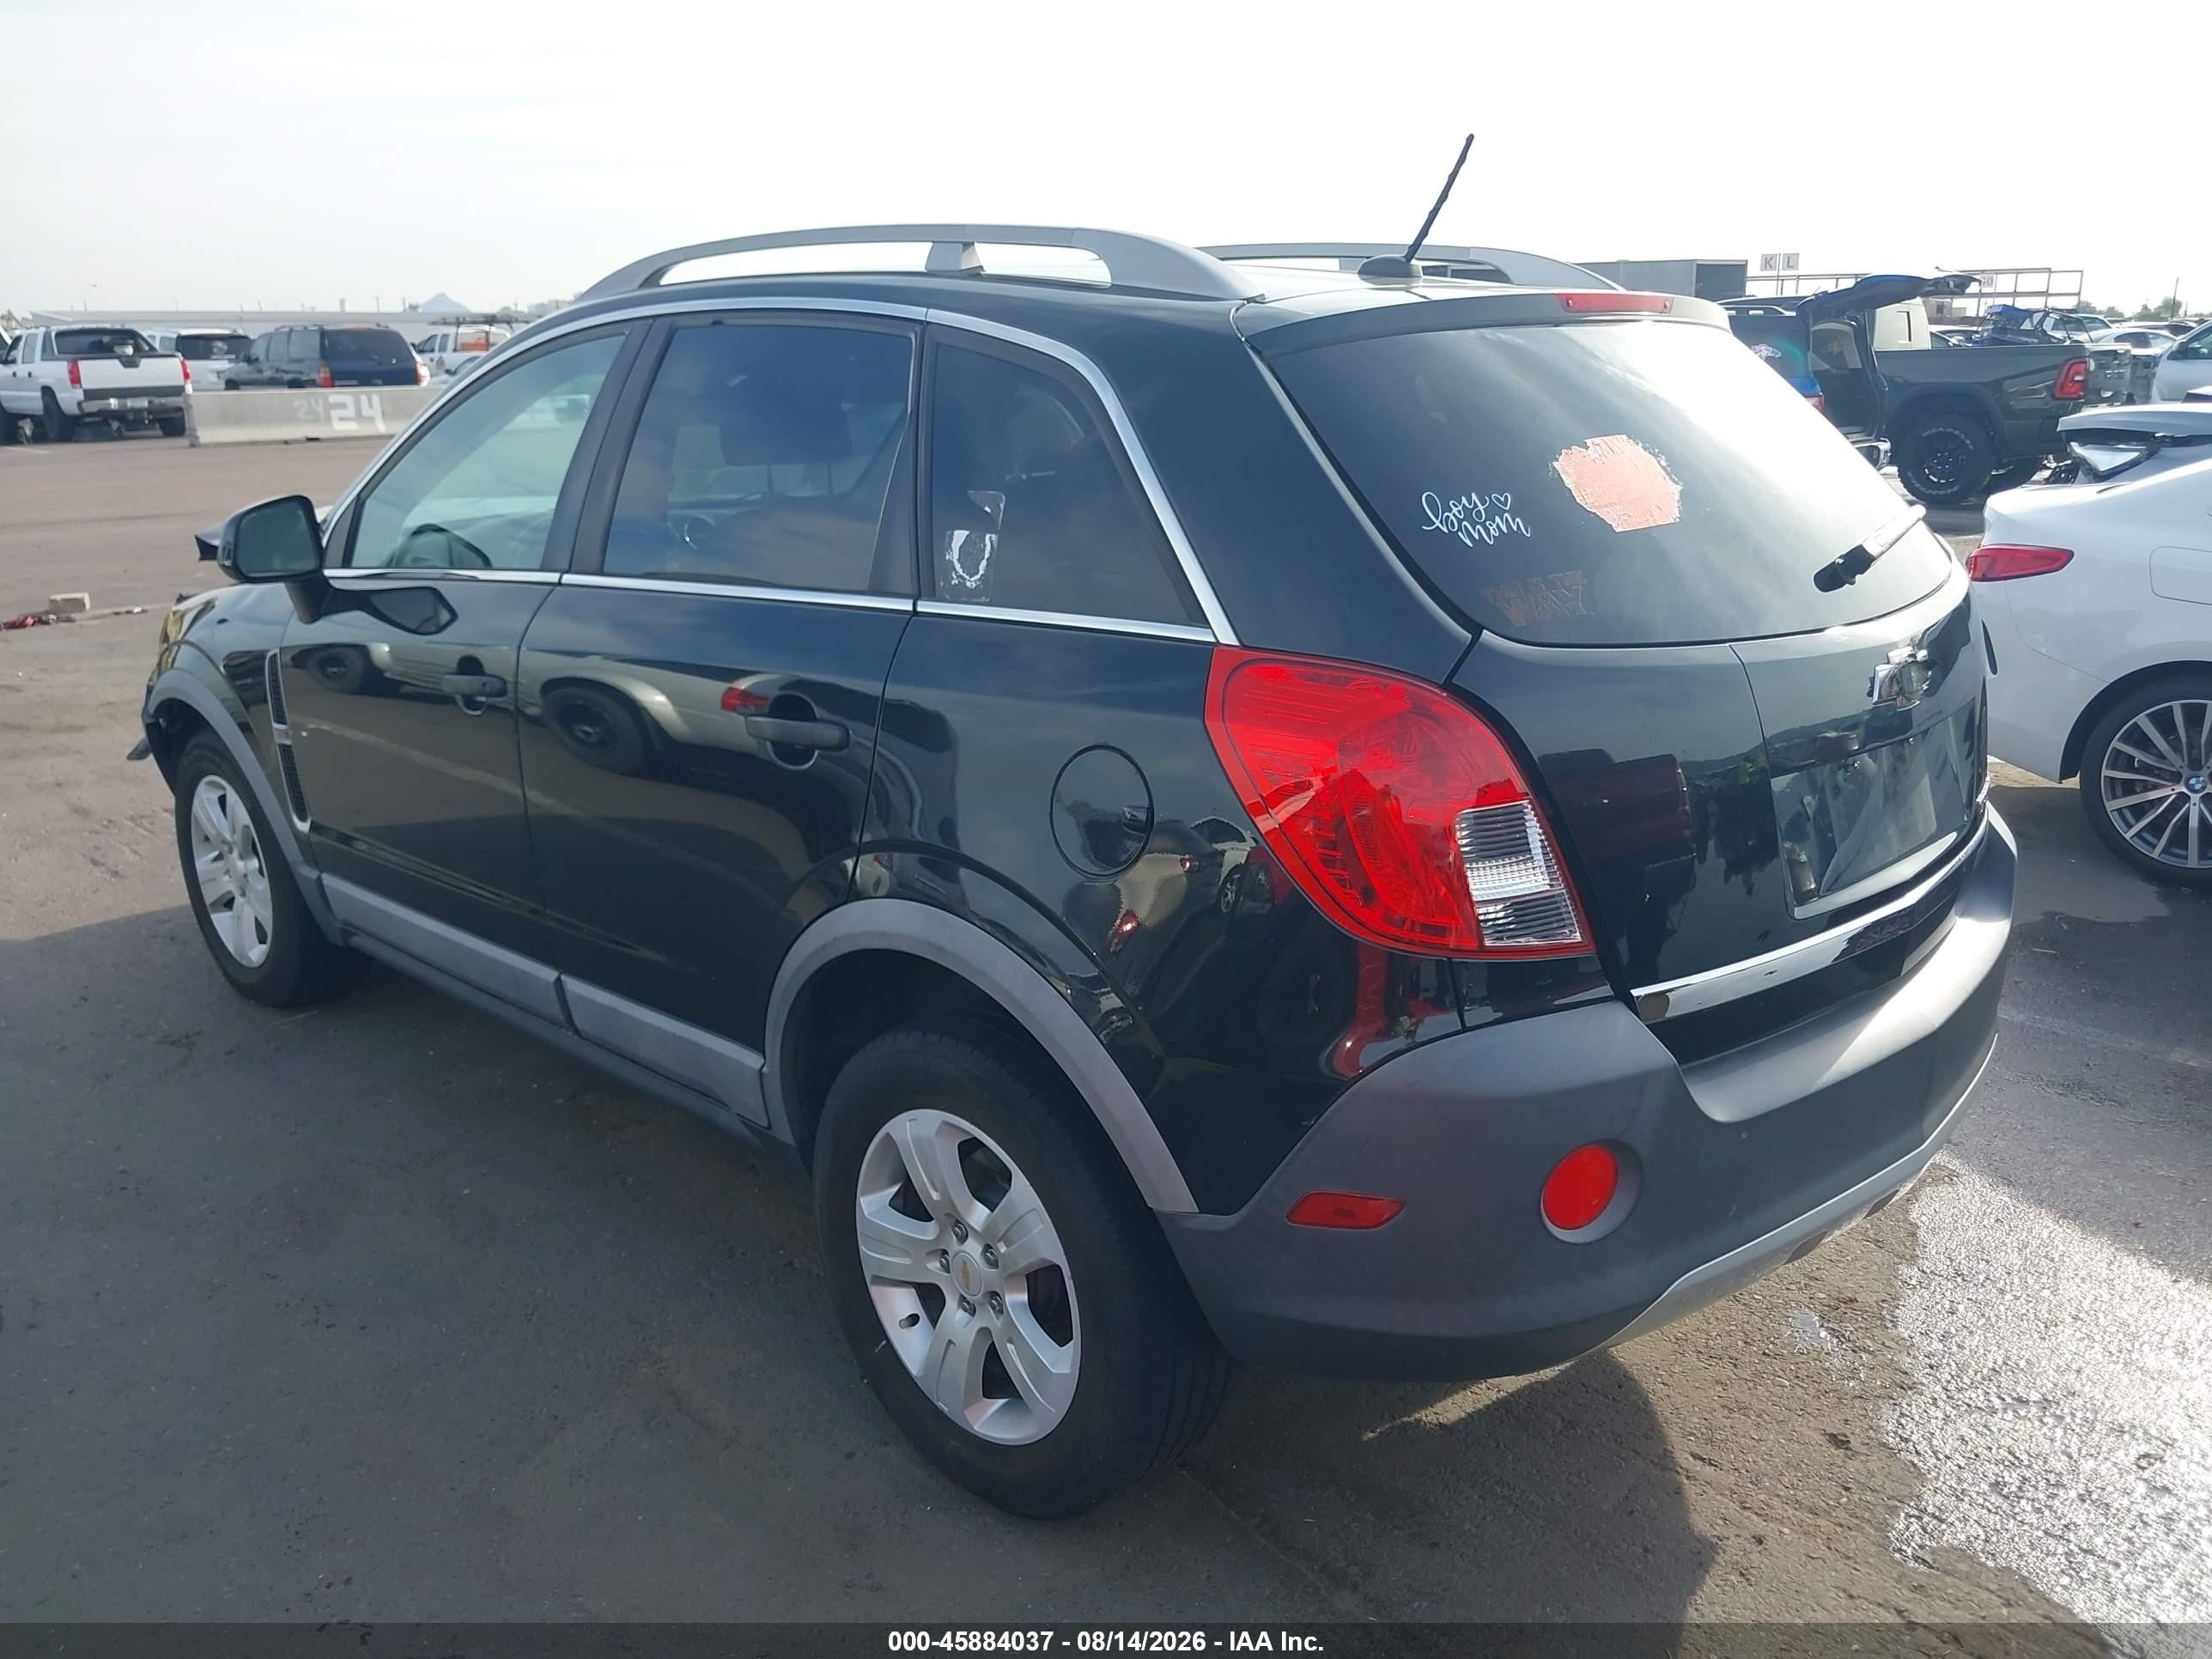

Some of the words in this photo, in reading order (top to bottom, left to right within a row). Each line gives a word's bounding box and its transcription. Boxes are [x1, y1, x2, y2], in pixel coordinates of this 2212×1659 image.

[1764, 256, 1774, 269] K
[1786, 256, 1795, 268] L
[293, 398, 325, 422] 24
[328, 394, 386, 432] 24
[1421, 491, 1490, 534] boy
[1458, 513, 1532, 548] mom
